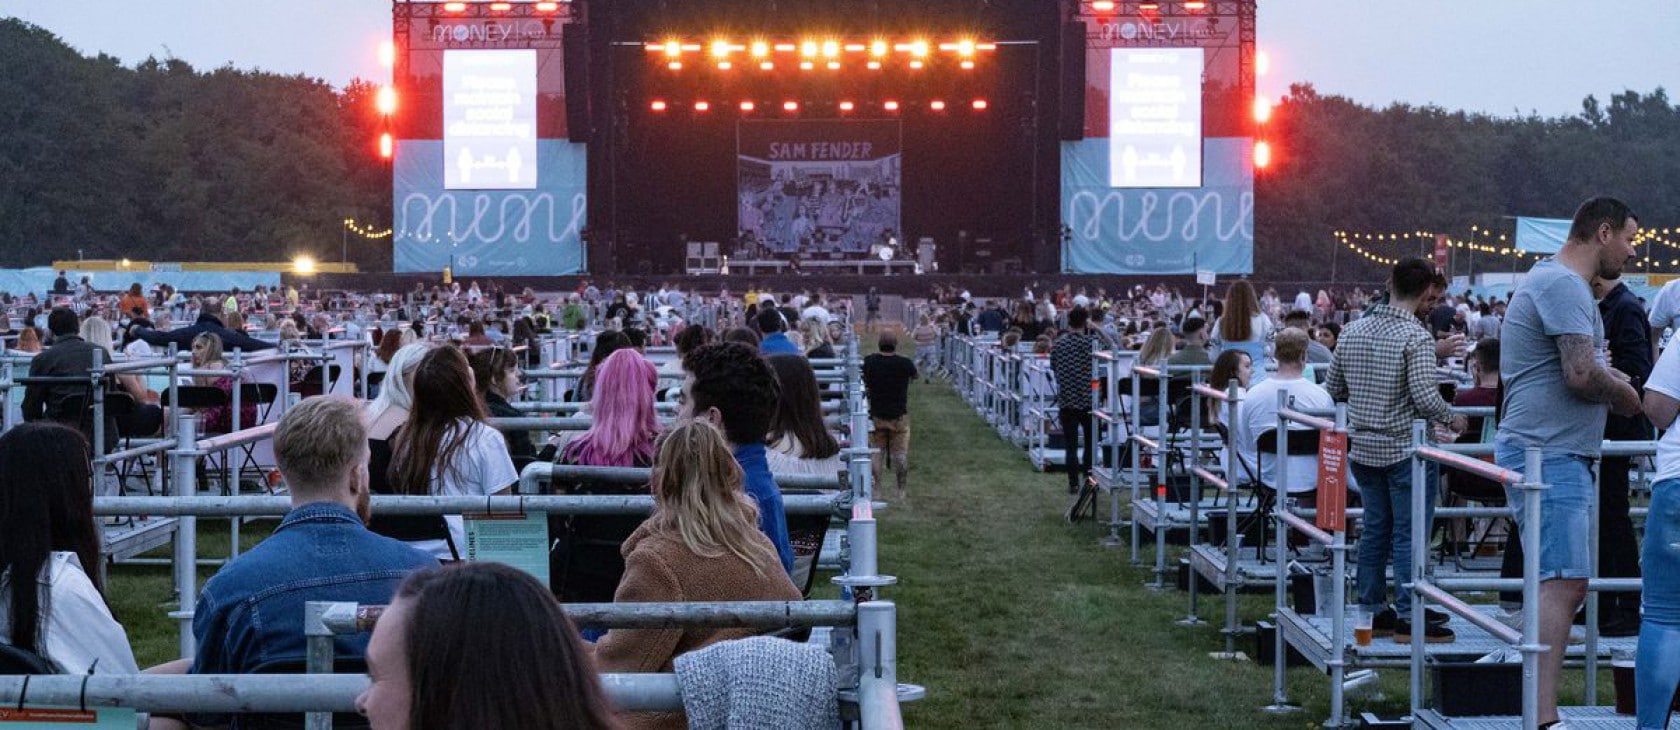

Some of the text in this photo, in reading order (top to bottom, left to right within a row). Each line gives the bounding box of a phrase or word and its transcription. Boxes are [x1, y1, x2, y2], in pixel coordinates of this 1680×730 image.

[433, 24, 513, 43] MONEY
[1100, 22, 1180, 41] MONEY
[768, 142, 873, 159] SAM FENDER
[468, 531, 476, 562] DELINES
